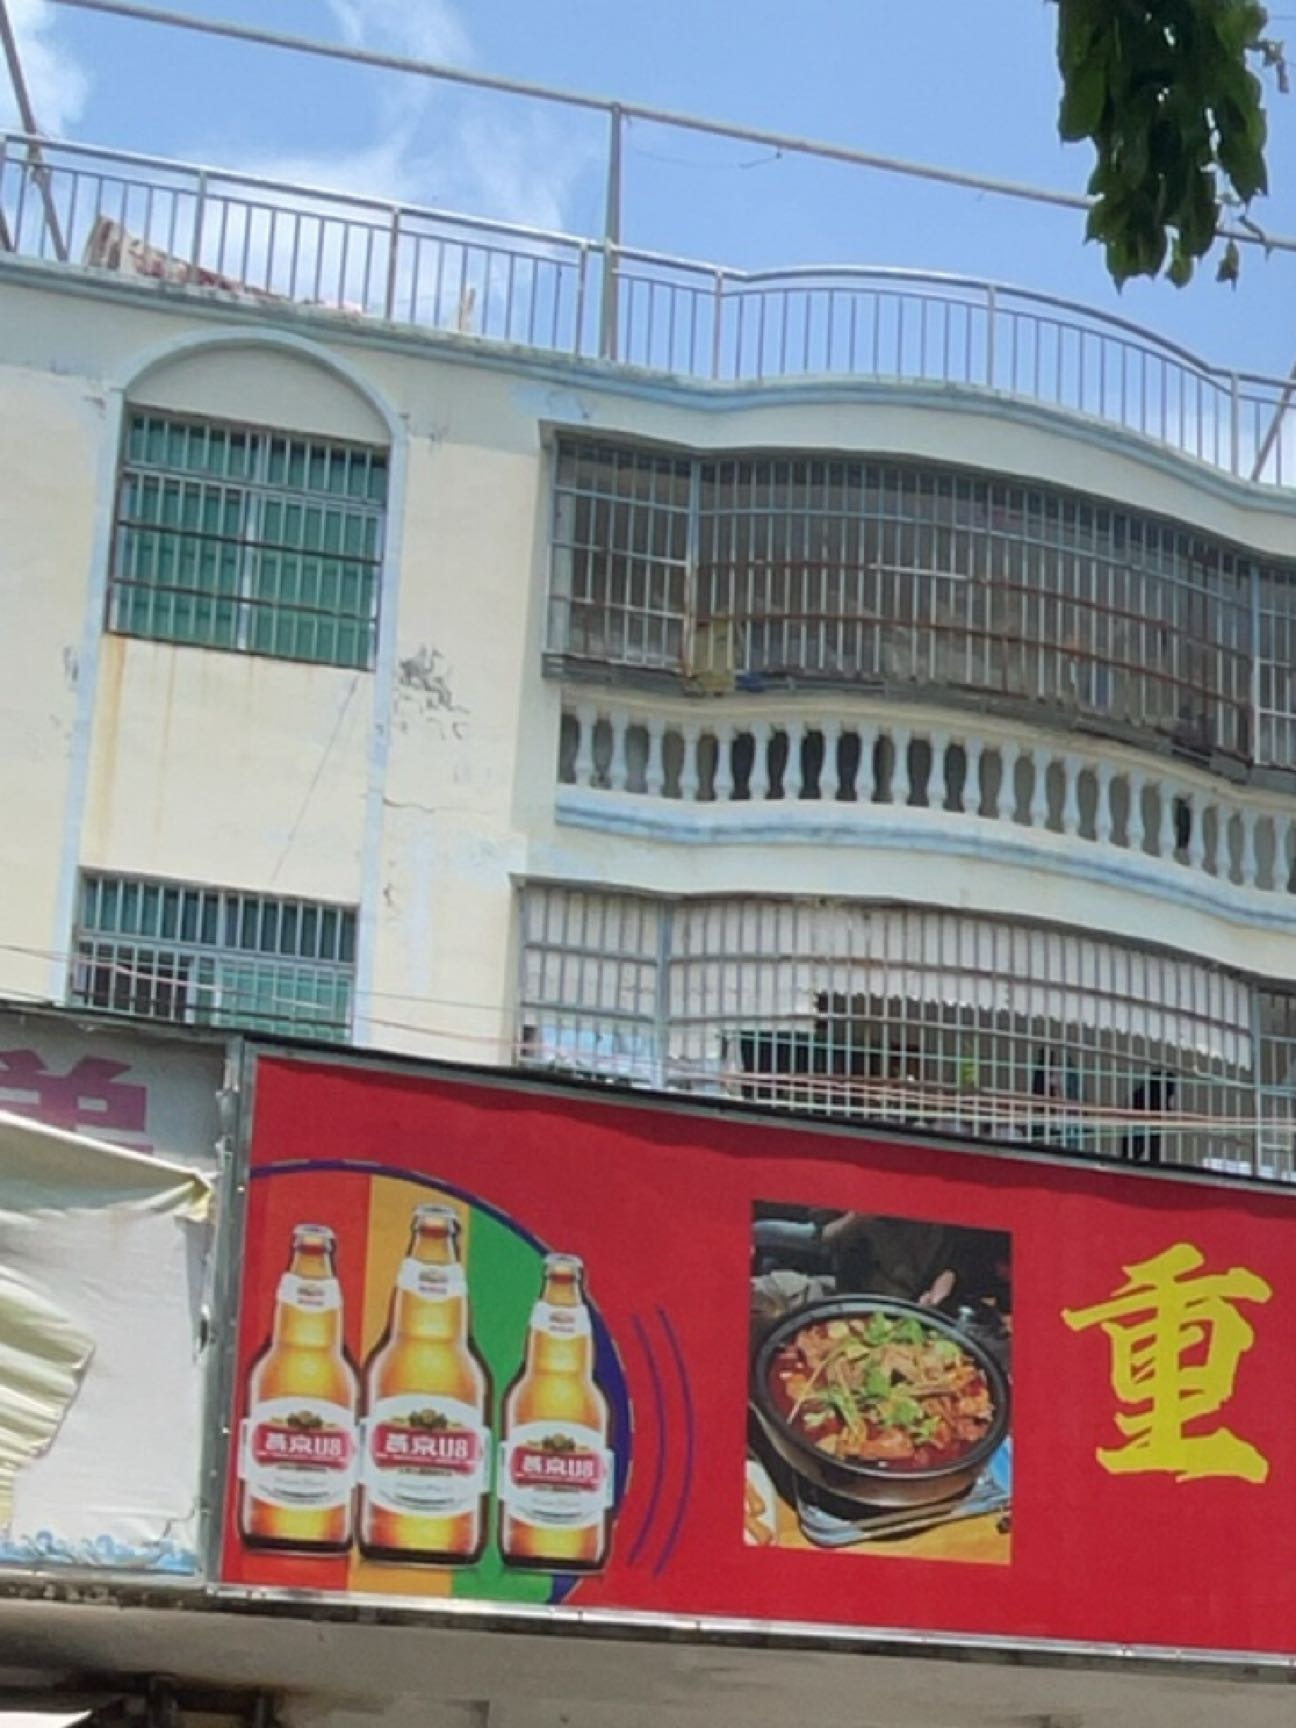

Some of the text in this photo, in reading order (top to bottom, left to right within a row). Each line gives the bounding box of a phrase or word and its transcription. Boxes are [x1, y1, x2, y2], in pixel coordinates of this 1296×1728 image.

[264, 1431, 344, 1457] 燕京U8
[385, 1432, 470, 1459] 燕京U8
[521, 1453, 595, 1479] 燕京U8
